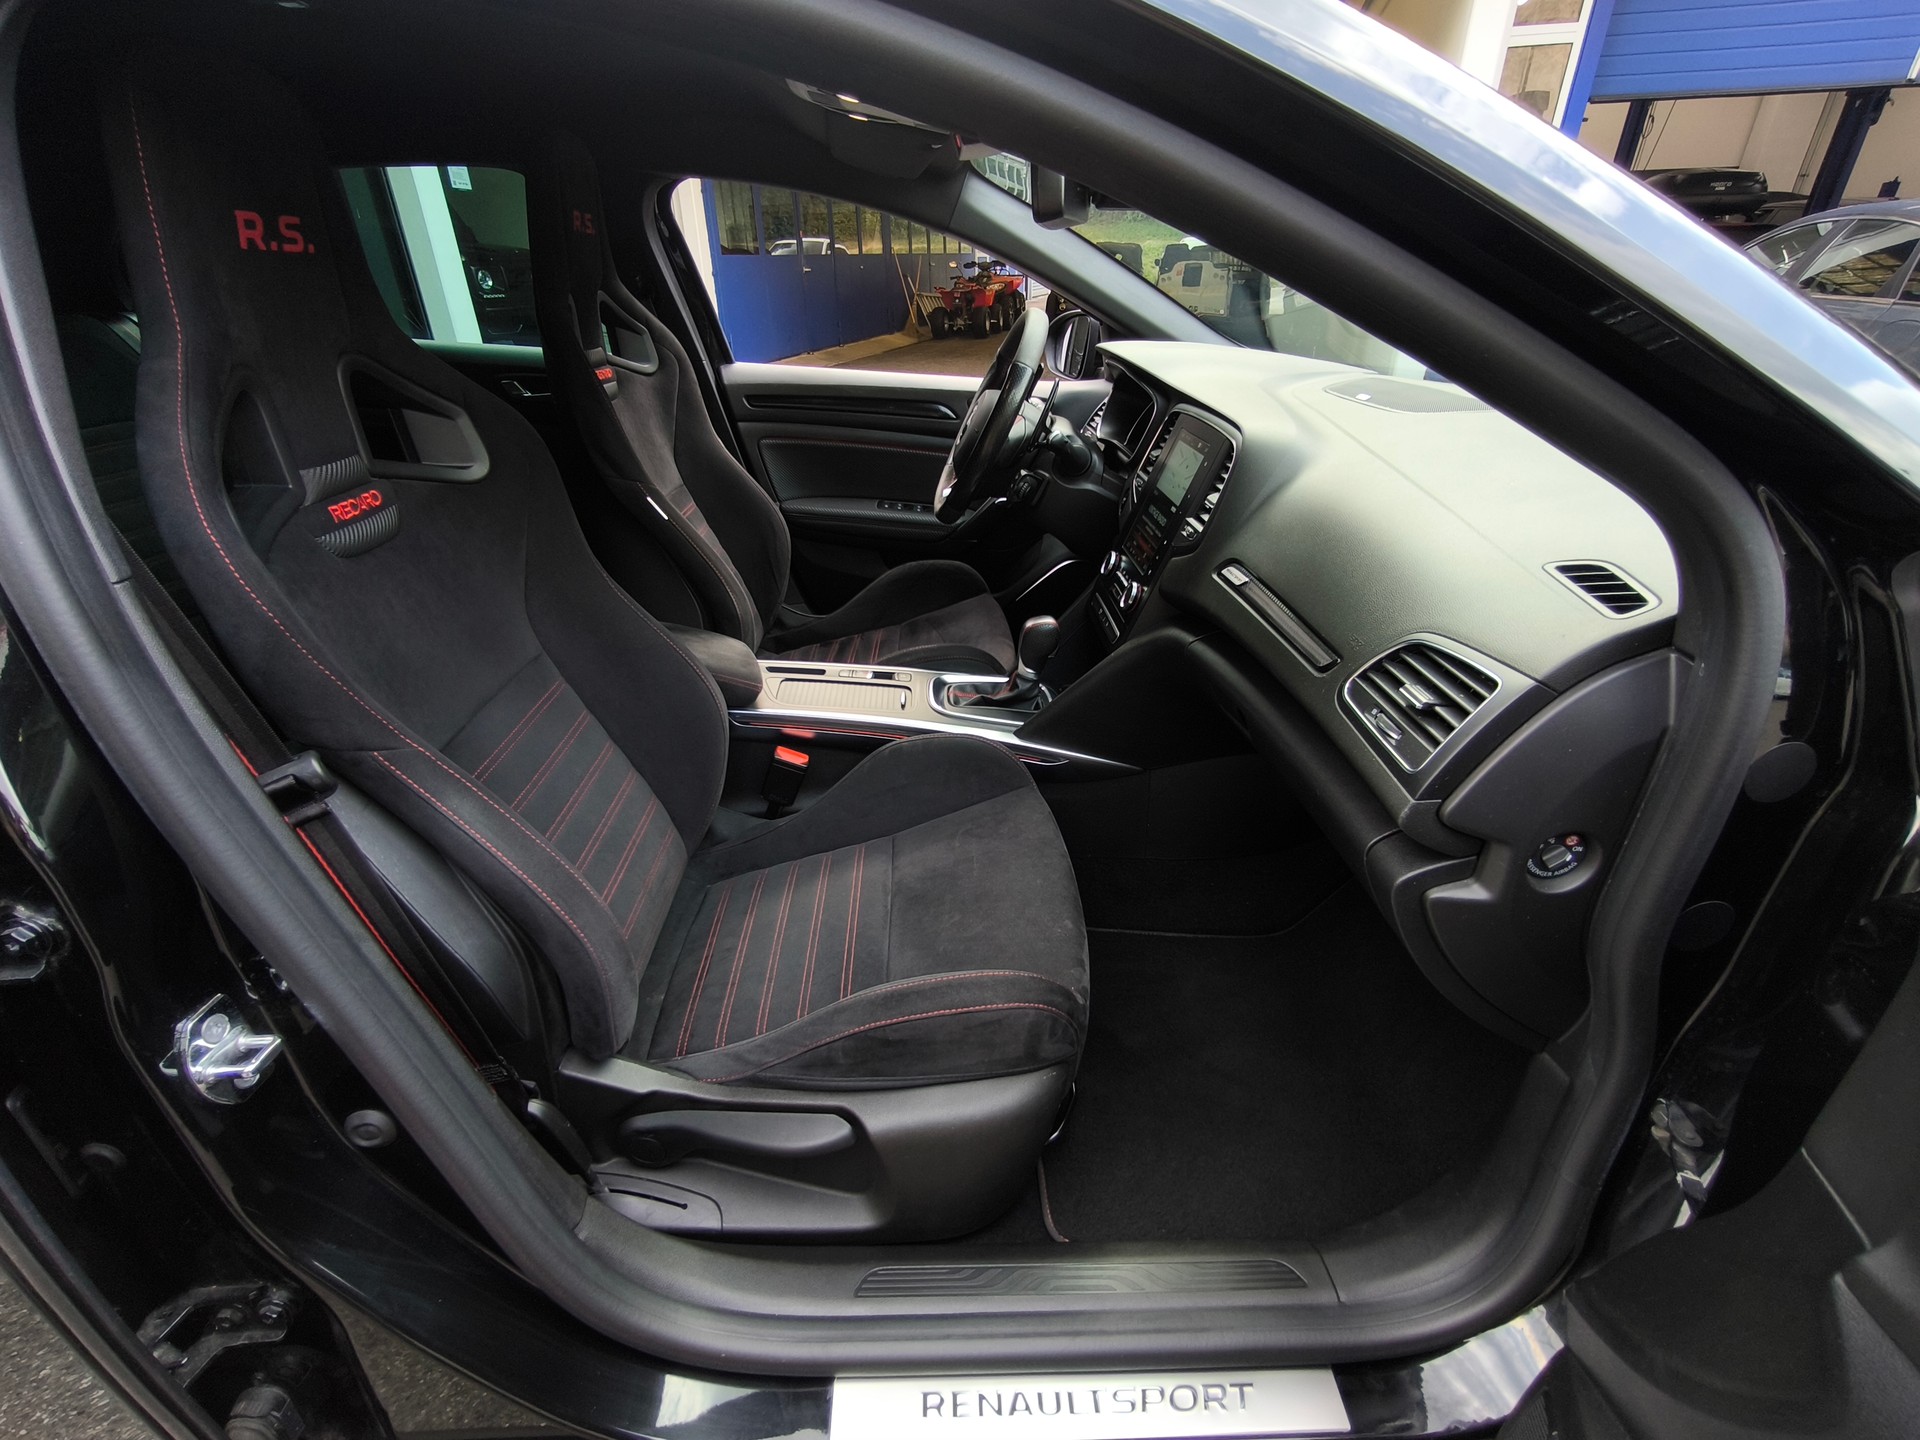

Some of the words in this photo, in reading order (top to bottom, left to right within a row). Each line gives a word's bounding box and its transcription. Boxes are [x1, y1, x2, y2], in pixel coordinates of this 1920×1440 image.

[234, 209, 315, 254] R.S.
[327, 489, 383, 523] RECARO
[1553, 861, 1578, 876] AIRBAG
